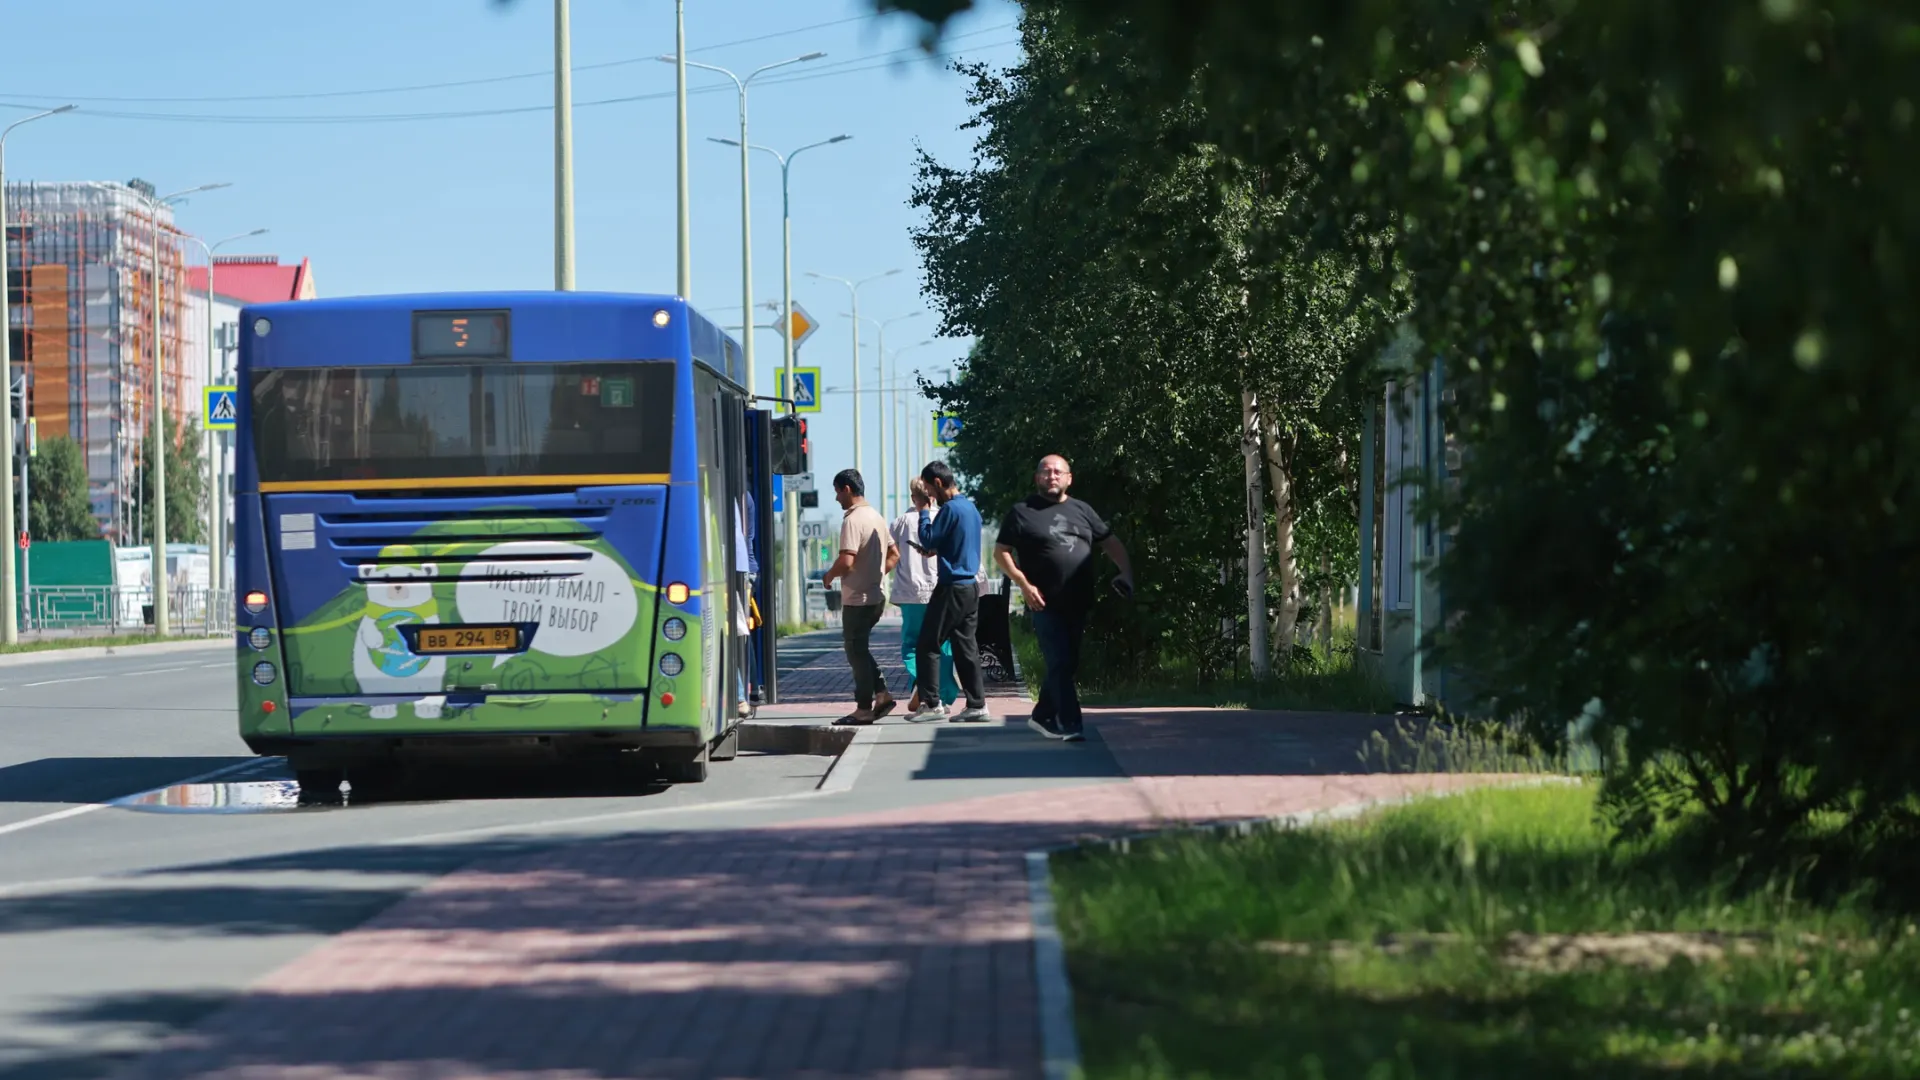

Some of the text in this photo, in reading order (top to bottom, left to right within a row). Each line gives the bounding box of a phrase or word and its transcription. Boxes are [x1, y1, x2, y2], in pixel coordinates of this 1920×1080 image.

[452, 319, 469, 348] 5
[485, 564, 550, 596] ЧИСТЫЙ
[555, 578, 605, 603] ЯМАЛ
[502, 599, 599, 633] ТВОЙ ВЫБОР
[454, 631, 486, 647] 294
[494, 629, 511, 641] 89
